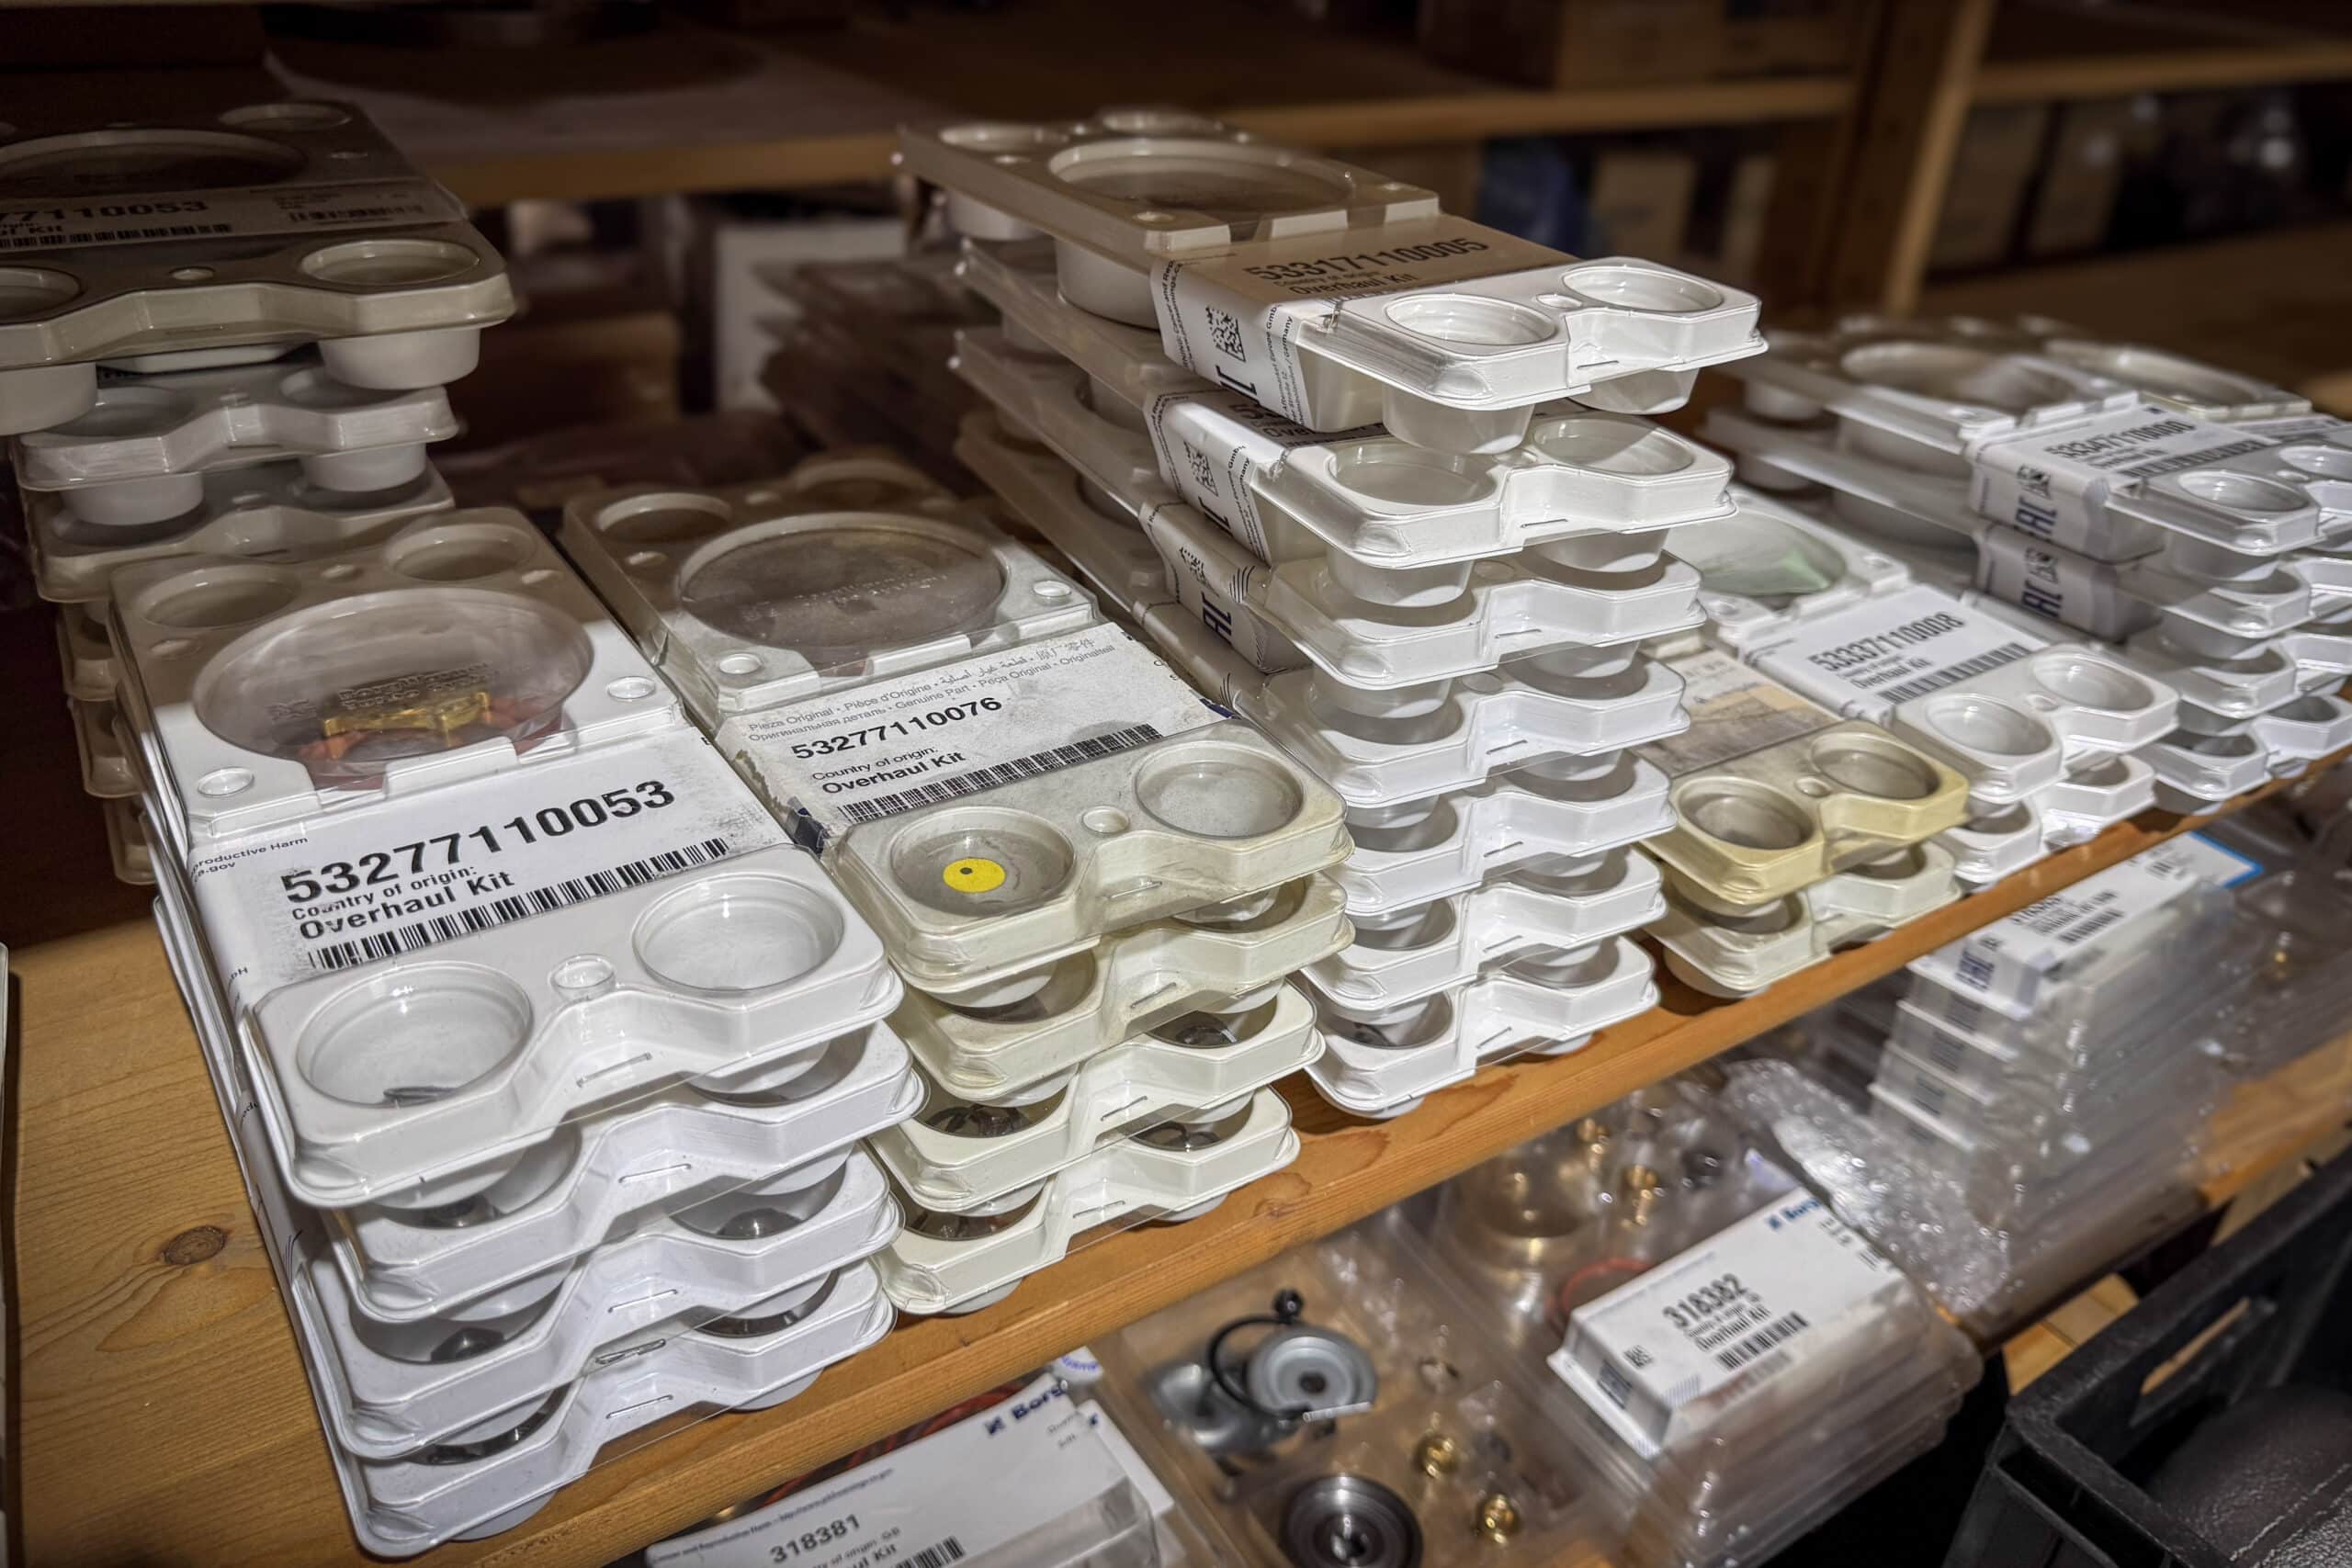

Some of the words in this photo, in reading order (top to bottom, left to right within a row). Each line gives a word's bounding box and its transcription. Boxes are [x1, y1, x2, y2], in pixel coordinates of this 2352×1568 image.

[1242, 237, 1489, 281] 53317110005
[1289, 278, 1386, 295] Overhaul
[1386, 273, 1421, 285] Kit
[1808, 612, 1964, 671] 53337110008
[895, 692, 944, 709] Genuine
[944, 683, 969, 697] Part
[1009, 662, 1052, 679] Original
[749, 720, 785, 731] Pieza
[786, 708, 834, 724] Original
[792, 697, 1002, 760] 53277110076
[811, 762, 872, 782] Country
[876, 757, 890, 768] of
[895, 746, 938, 763] origin:
[821, 761, 928, 795] Overhaul
[933, 750, 967, 769] Kit
[269, 837, 310, 851] Harm
[280, 779, 676, 904] 53277110053
[291, 887, 378, 920] Country
[382, 881, 405, 897] of
[408, 865, 479, 893] origin:
[300, 886, 458, 941] Overhaul
[471, 870, 515, 897] Kit
[1661, 1273, 1747, 1329] 318382
[769, 1513, 860, 1564] 318381
[873, 1543, 898, 1562] Kit
